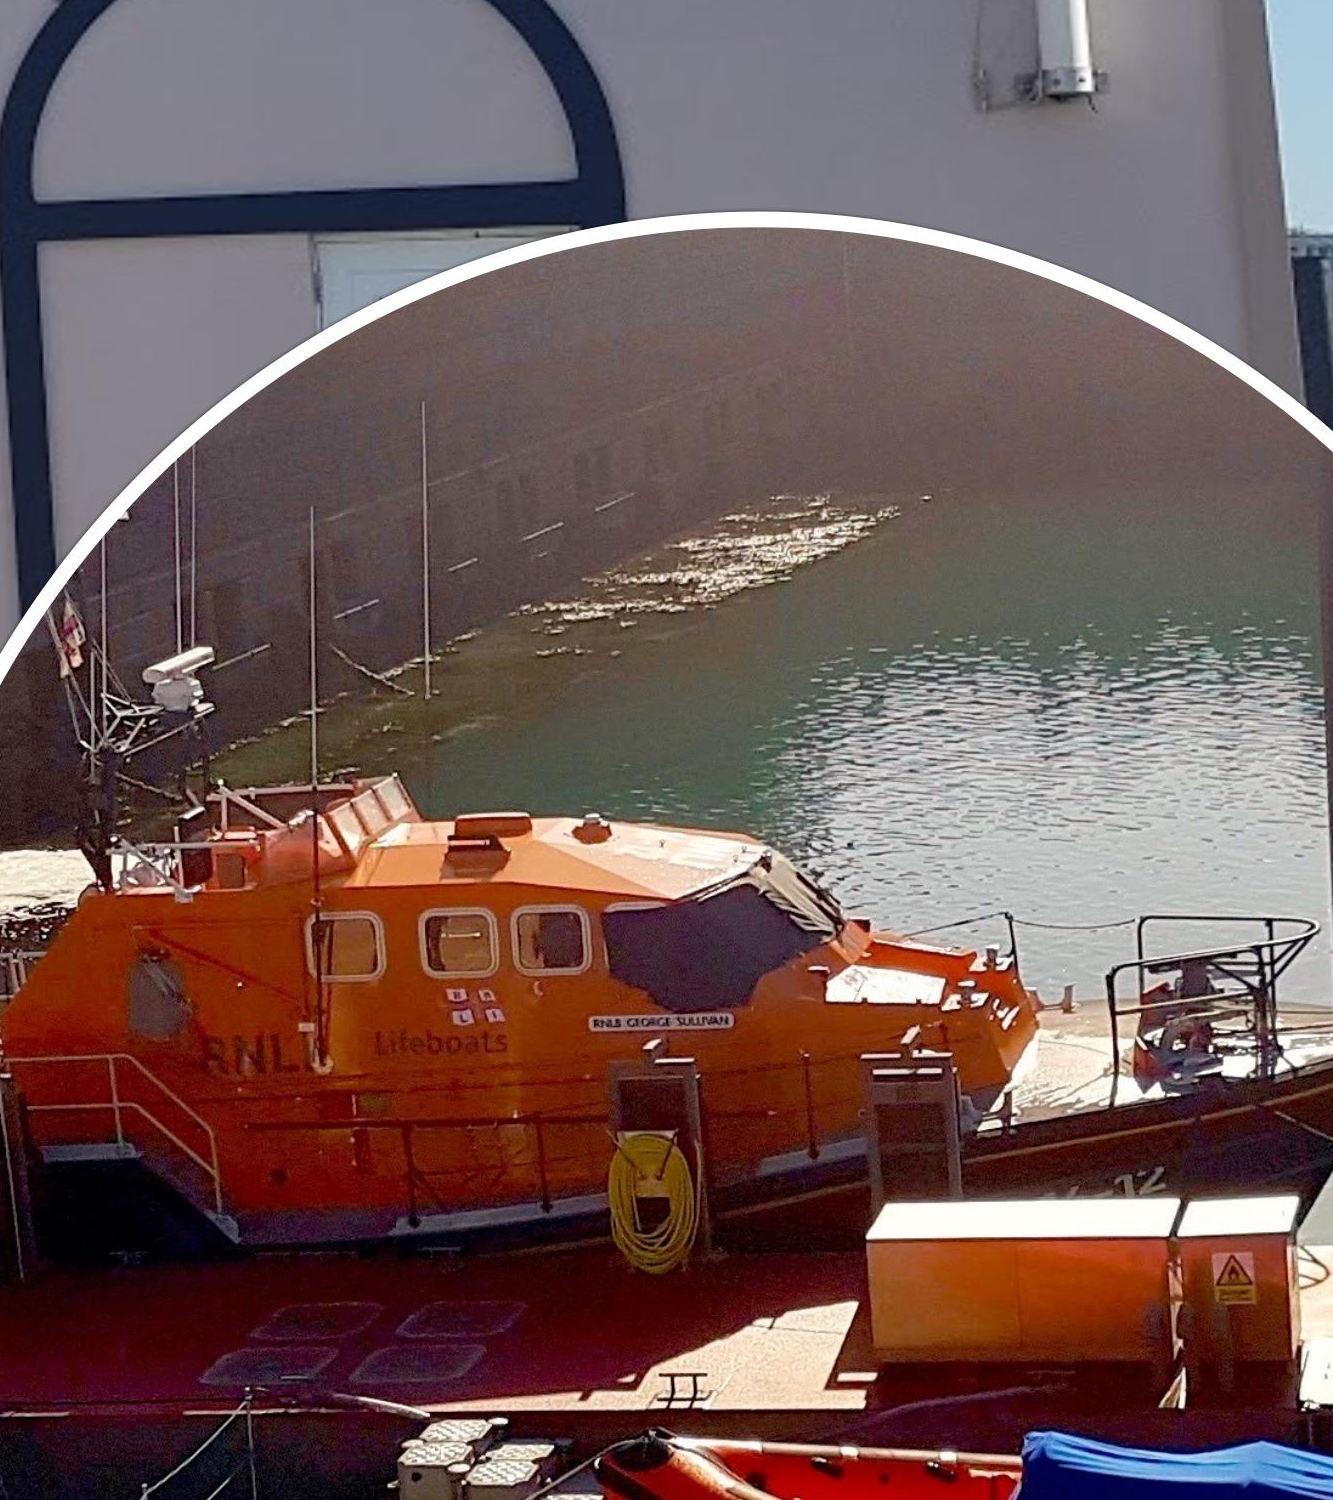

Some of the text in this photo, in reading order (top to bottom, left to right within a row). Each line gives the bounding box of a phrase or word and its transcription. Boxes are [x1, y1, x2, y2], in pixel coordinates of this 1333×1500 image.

[593, 1015, 730, 1029] RNLB GEORGE SULLIVAN
[373, 1029, 509, 1057] Lifeboats
